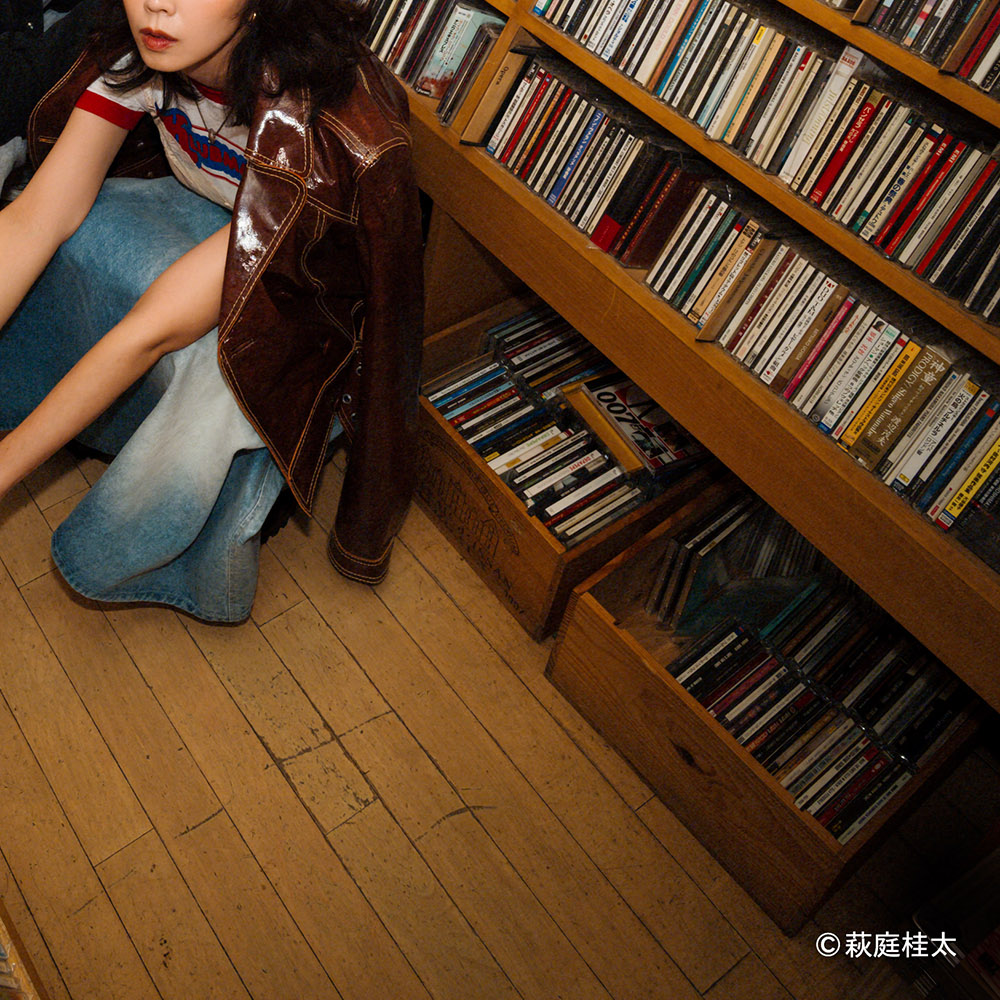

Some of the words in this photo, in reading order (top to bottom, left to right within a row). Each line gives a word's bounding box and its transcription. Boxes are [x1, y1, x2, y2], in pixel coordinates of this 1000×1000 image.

[935, 143, 948, 157] EMI
[948, 150, 960, 164] EMI
[906, 351, 934, 387] PRODIGY
